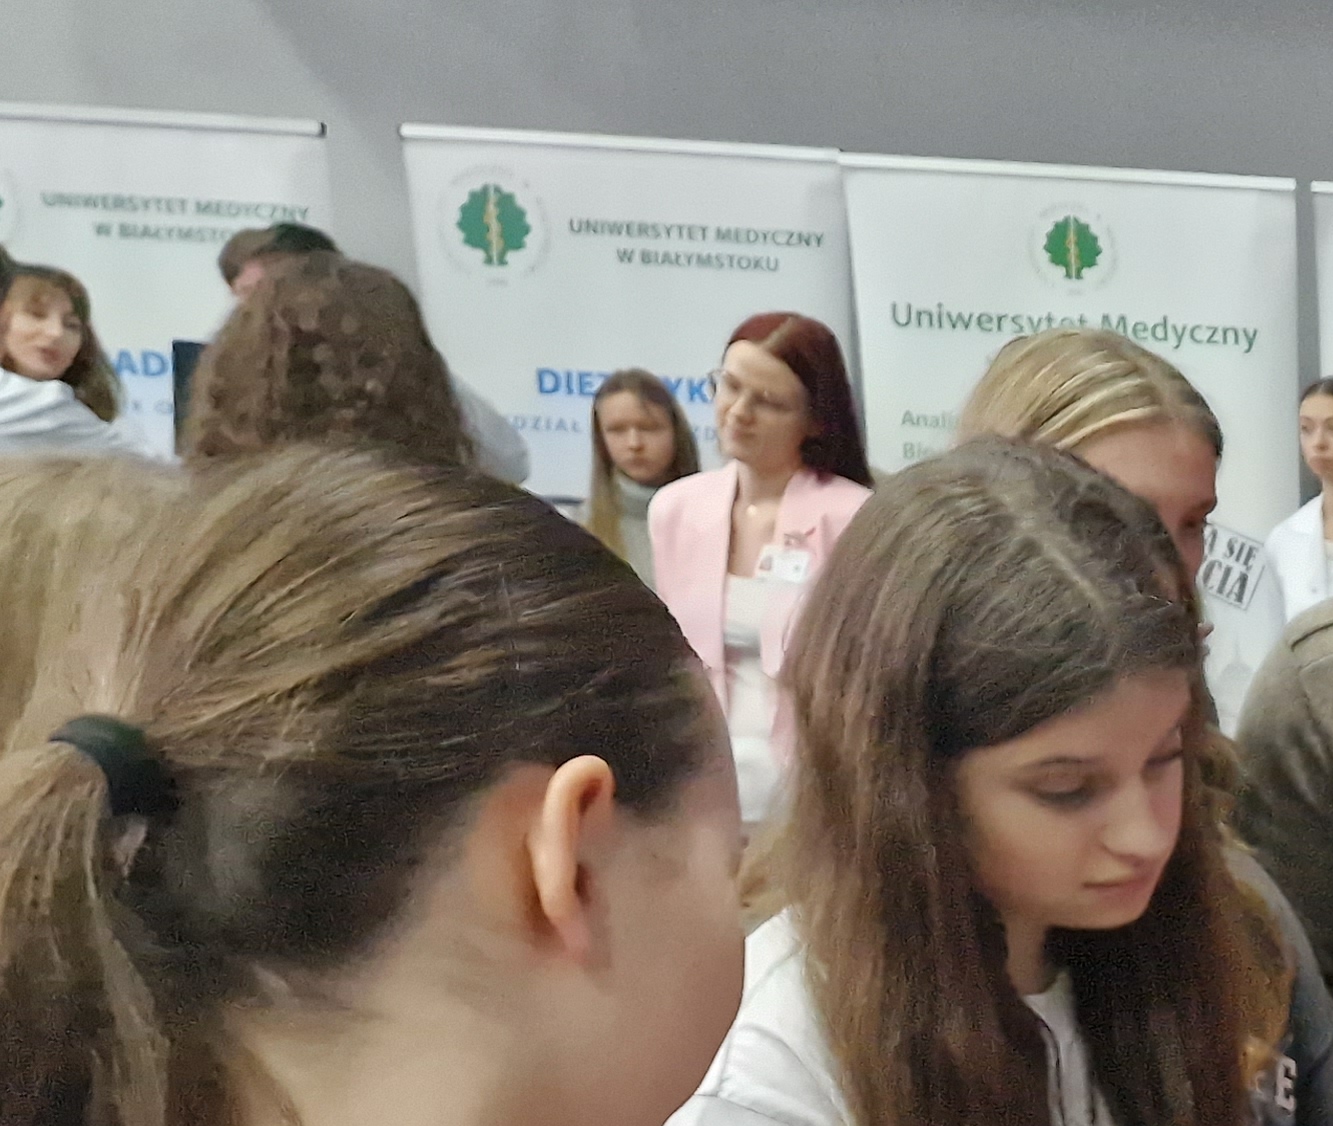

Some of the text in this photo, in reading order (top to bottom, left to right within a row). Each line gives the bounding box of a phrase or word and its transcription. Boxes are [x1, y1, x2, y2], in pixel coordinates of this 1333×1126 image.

[569, 218, 824, 248] UNIWERSYTET MEDYCZNY
[616, 248, 779, 272] W BIAŁYMSTOKU
[1099, 314, 1258, 353] Medyczny
